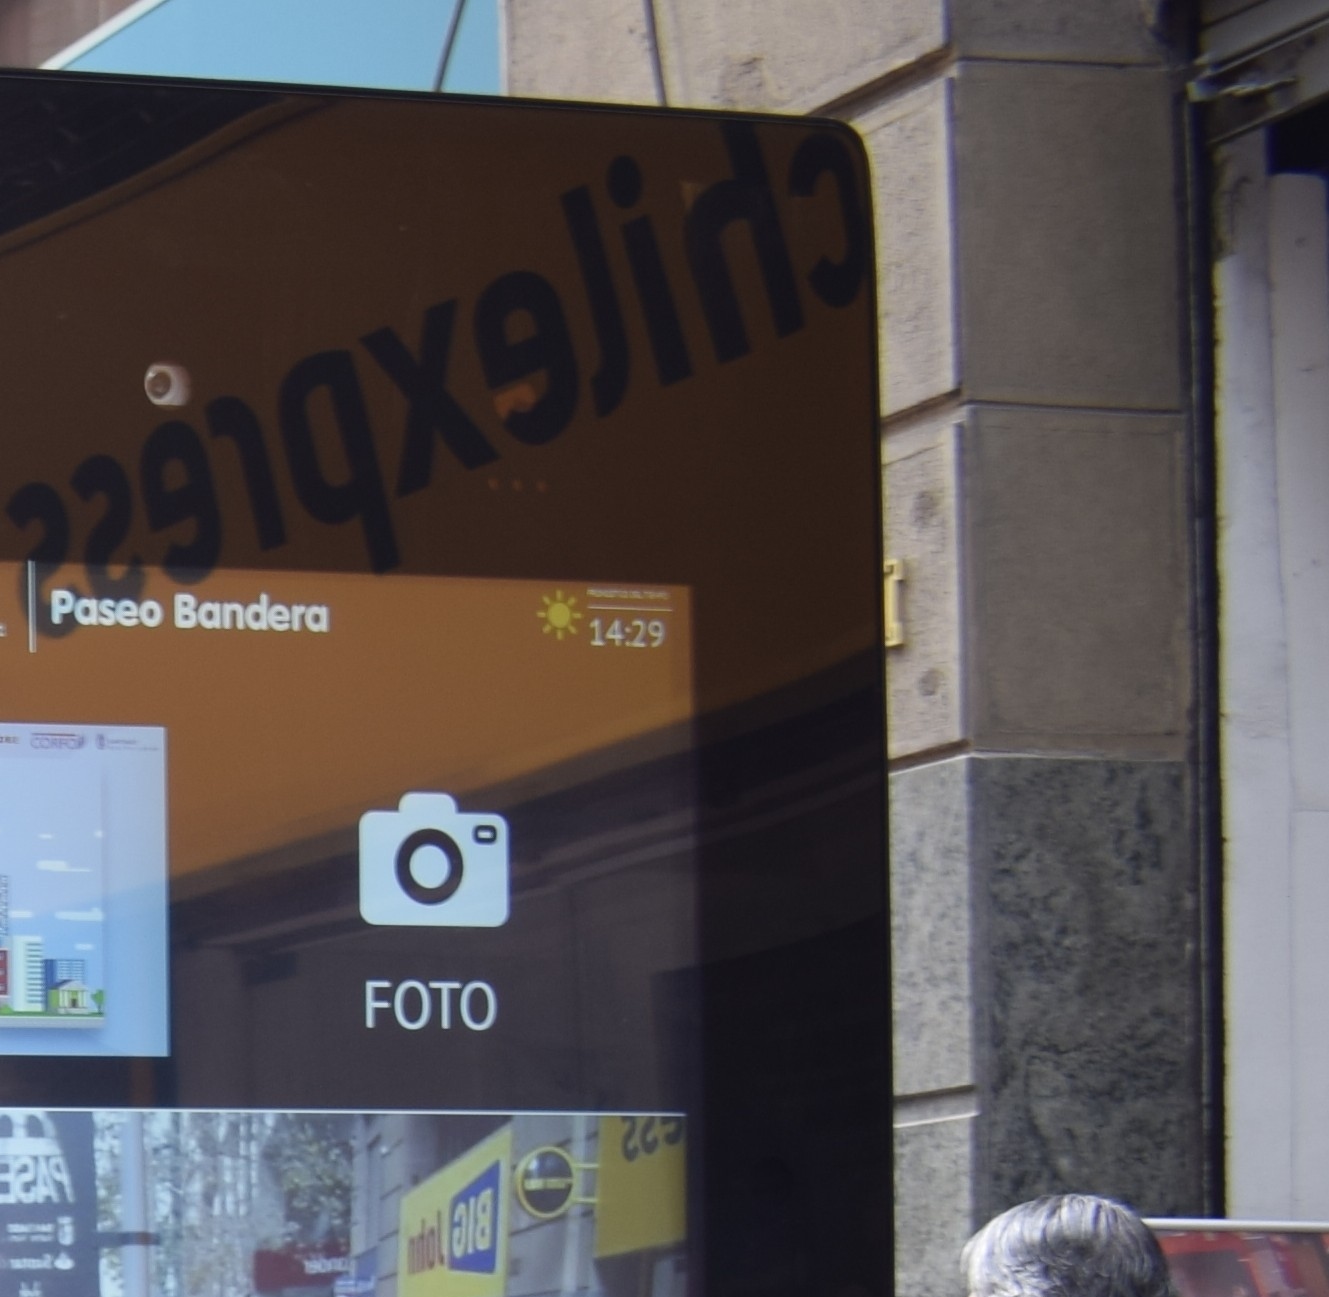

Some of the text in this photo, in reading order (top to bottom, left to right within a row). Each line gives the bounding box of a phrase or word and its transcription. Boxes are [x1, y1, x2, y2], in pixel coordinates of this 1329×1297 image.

[50, 589, 330, 633] Paseo Bandera
[588, 618, 667, 648] 14:29
[364, 979, 498, 1031] FOTO
